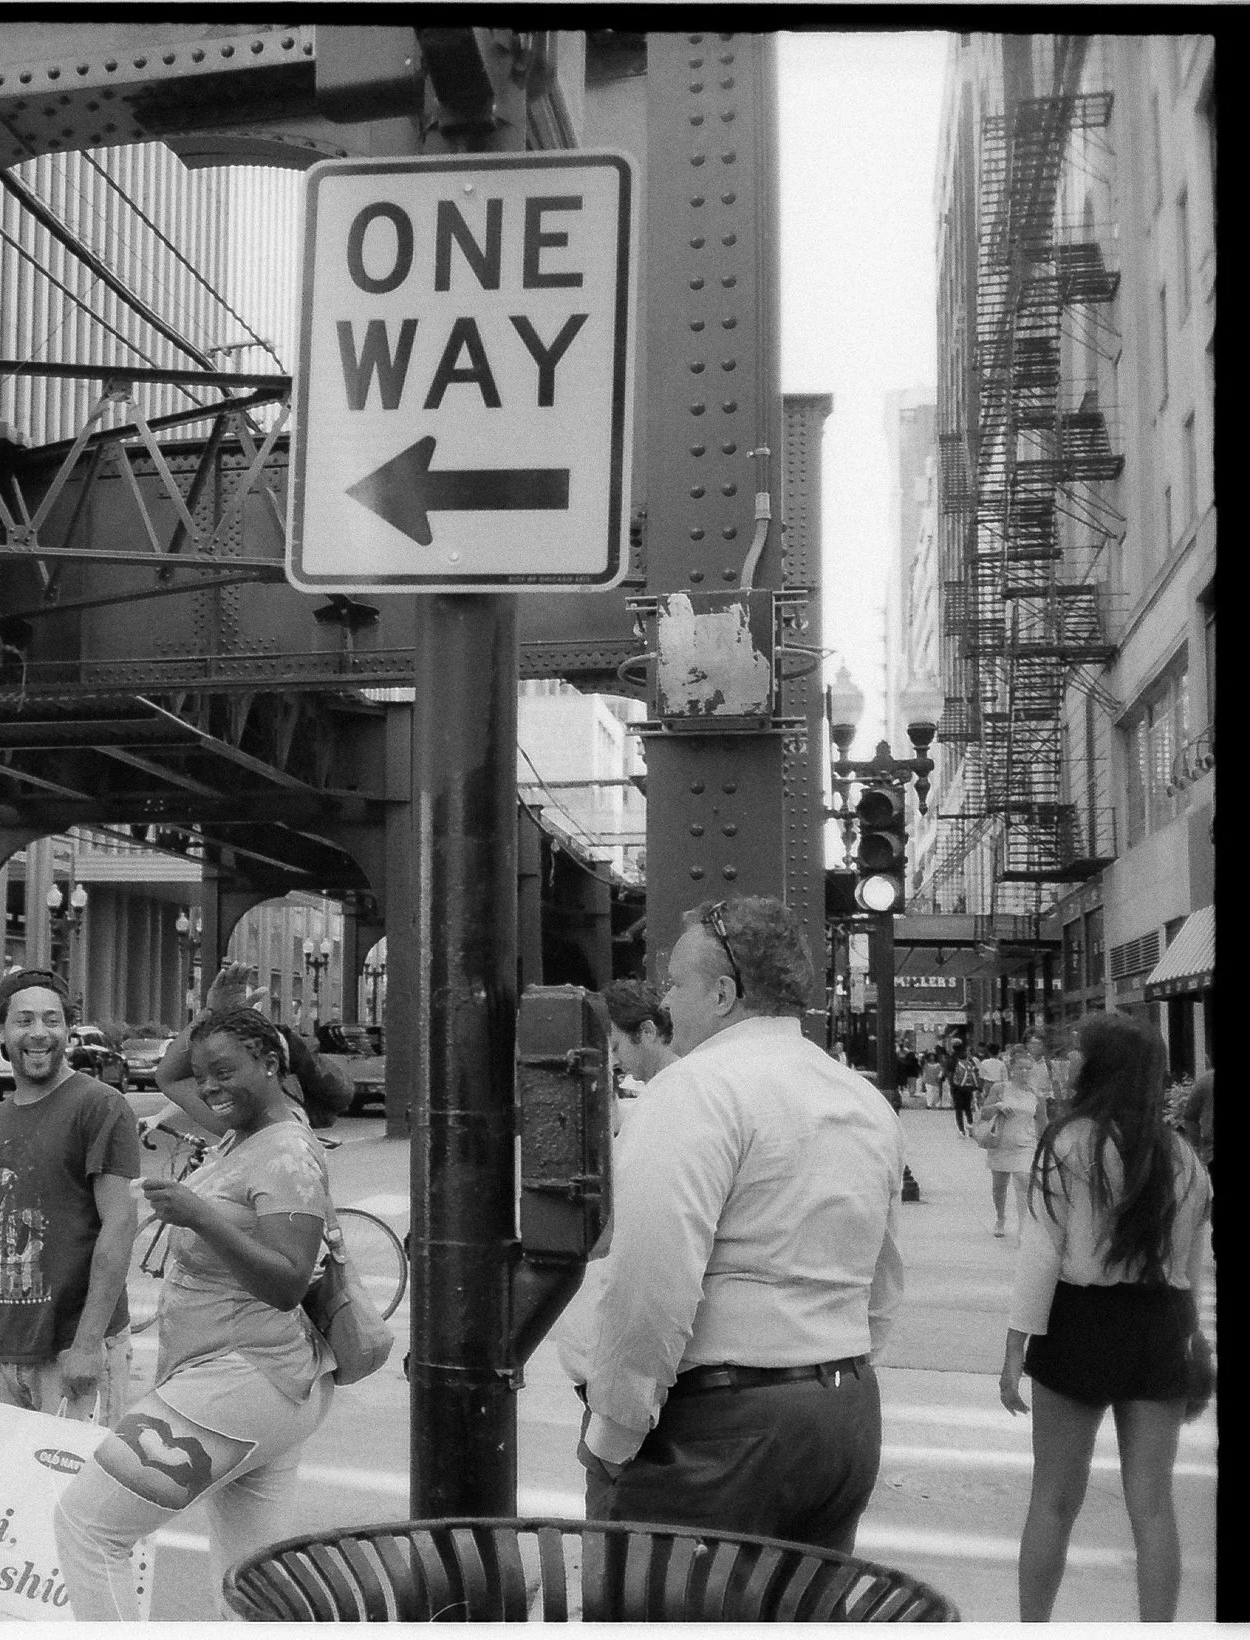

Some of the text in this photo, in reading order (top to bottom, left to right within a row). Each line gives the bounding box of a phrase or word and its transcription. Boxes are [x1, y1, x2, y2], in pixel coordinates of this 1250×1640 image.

[347, 195, 584, 294] ONE
[336, 313, 590, 411] WAY
[38, 1450, 61, 1466] OLD
